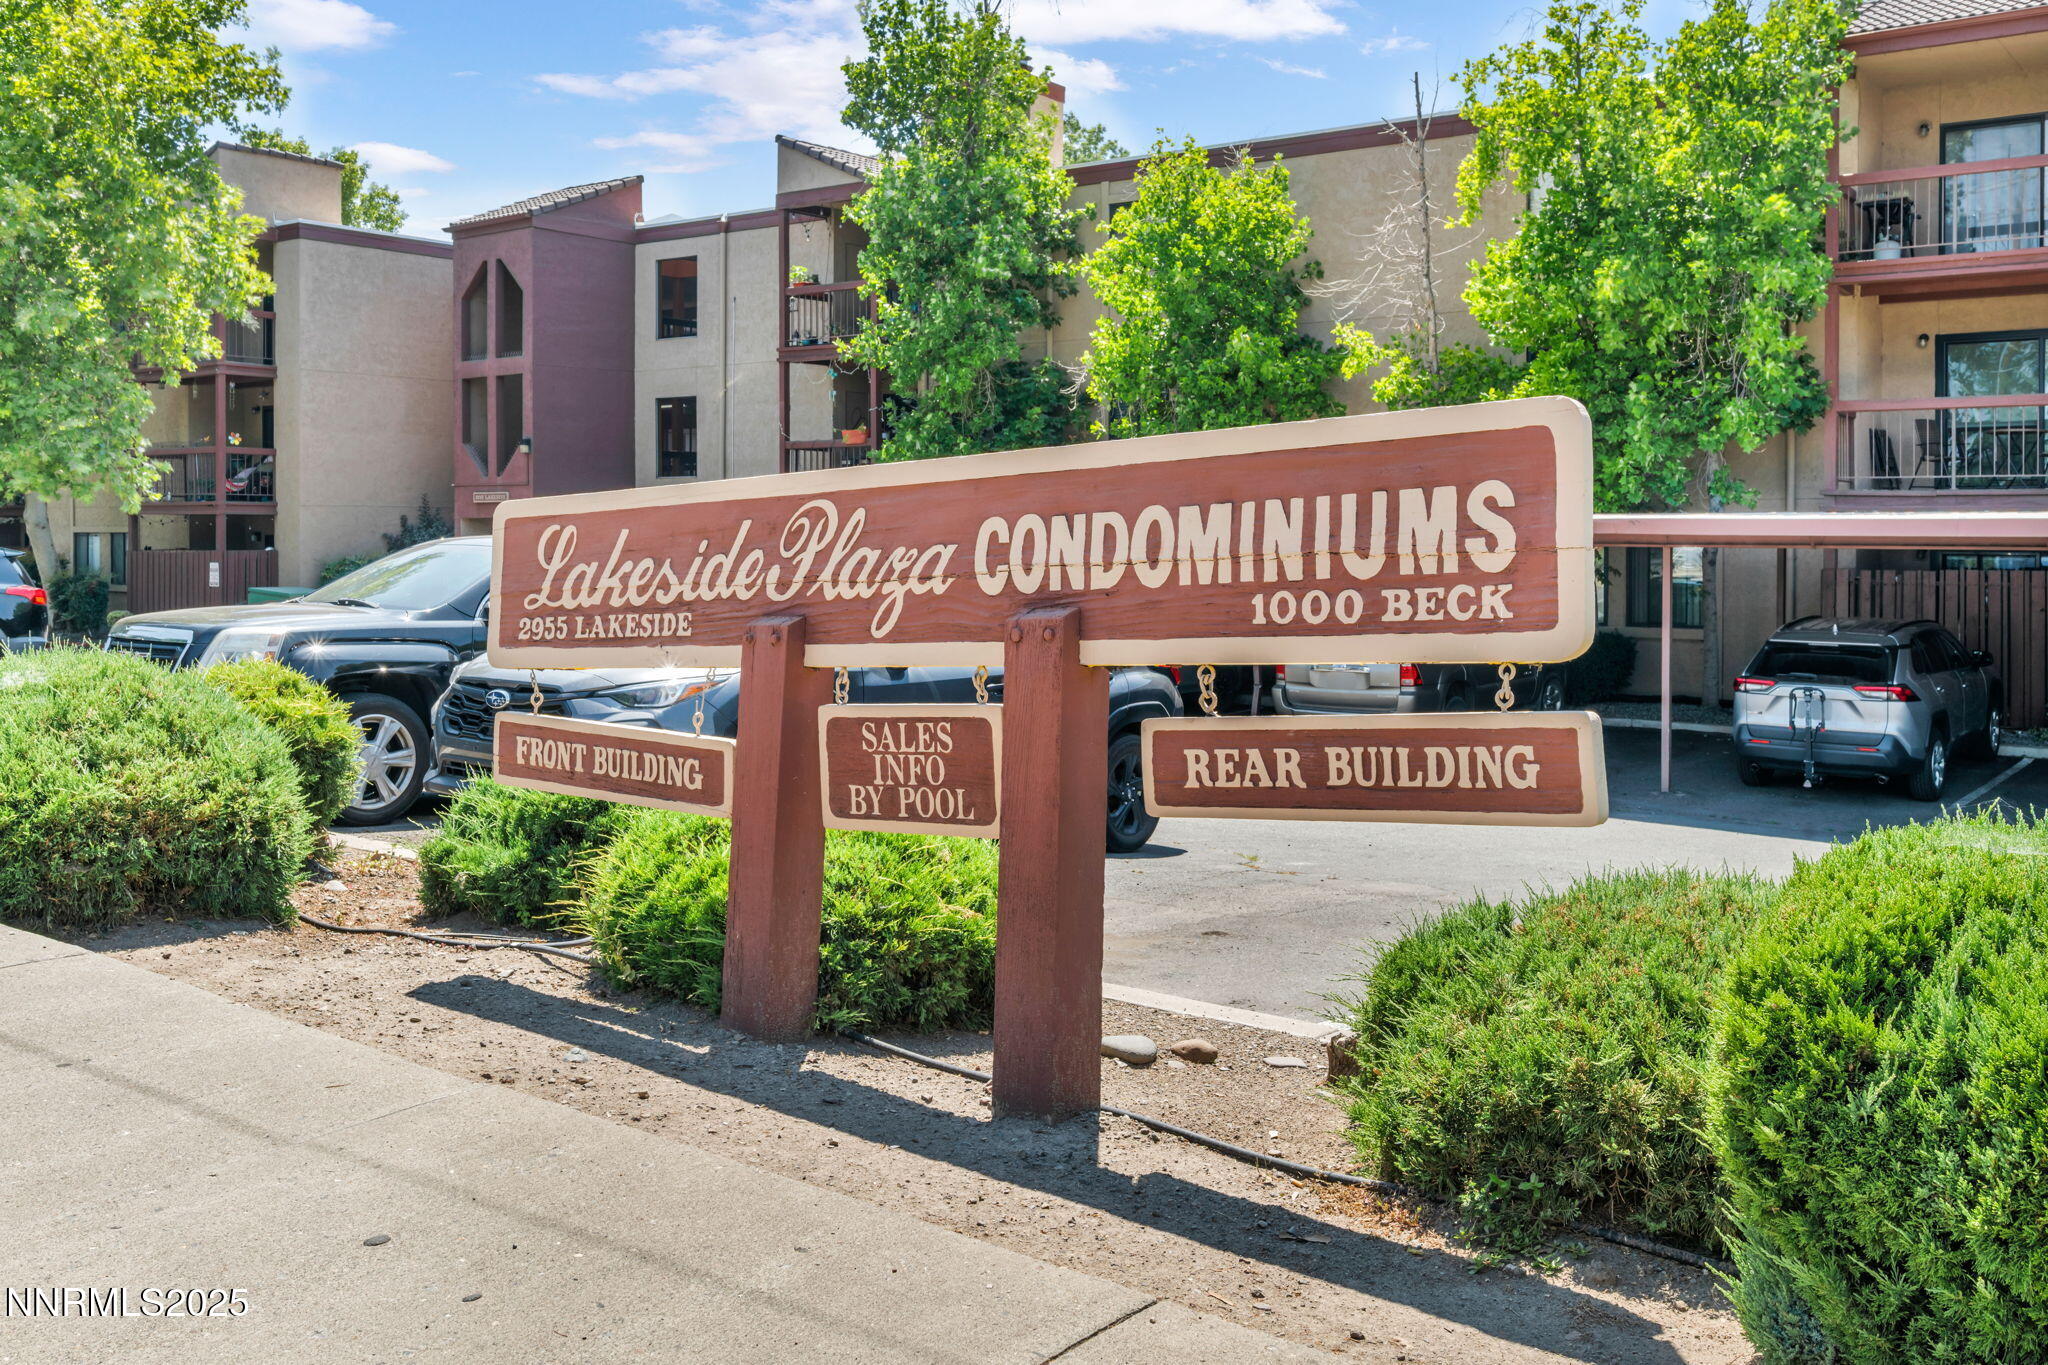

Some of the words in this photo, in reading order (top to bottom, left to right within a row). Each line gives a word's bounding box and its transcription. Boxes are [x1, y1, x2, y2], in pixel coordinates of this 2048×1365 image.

[523, 519, 764, 610] Lakeside
[765, 498, 958, 639] Plaza
[974, 479, 1517, 596] CONDOMINIUMS
[1252, 589, 1364, 625] 1000
[1381, 584, 1514, 622] BECK
[518, 616, 568, 641] 2955
[574, 612, 692, 639] LAKESIDE
[861, 722, 953, 754] SALES
[516, 736, 587, 773] FRONT
[592, 745, 704, 791] BUILDING
[873, 754, 946, 786] INFO
[1184, 747, 1307, 789] REAR
[1325, 745, 1541, 790] BUILDING
[848, 784, 885, 816] BY
[897, 788, 975, 821] POOL
